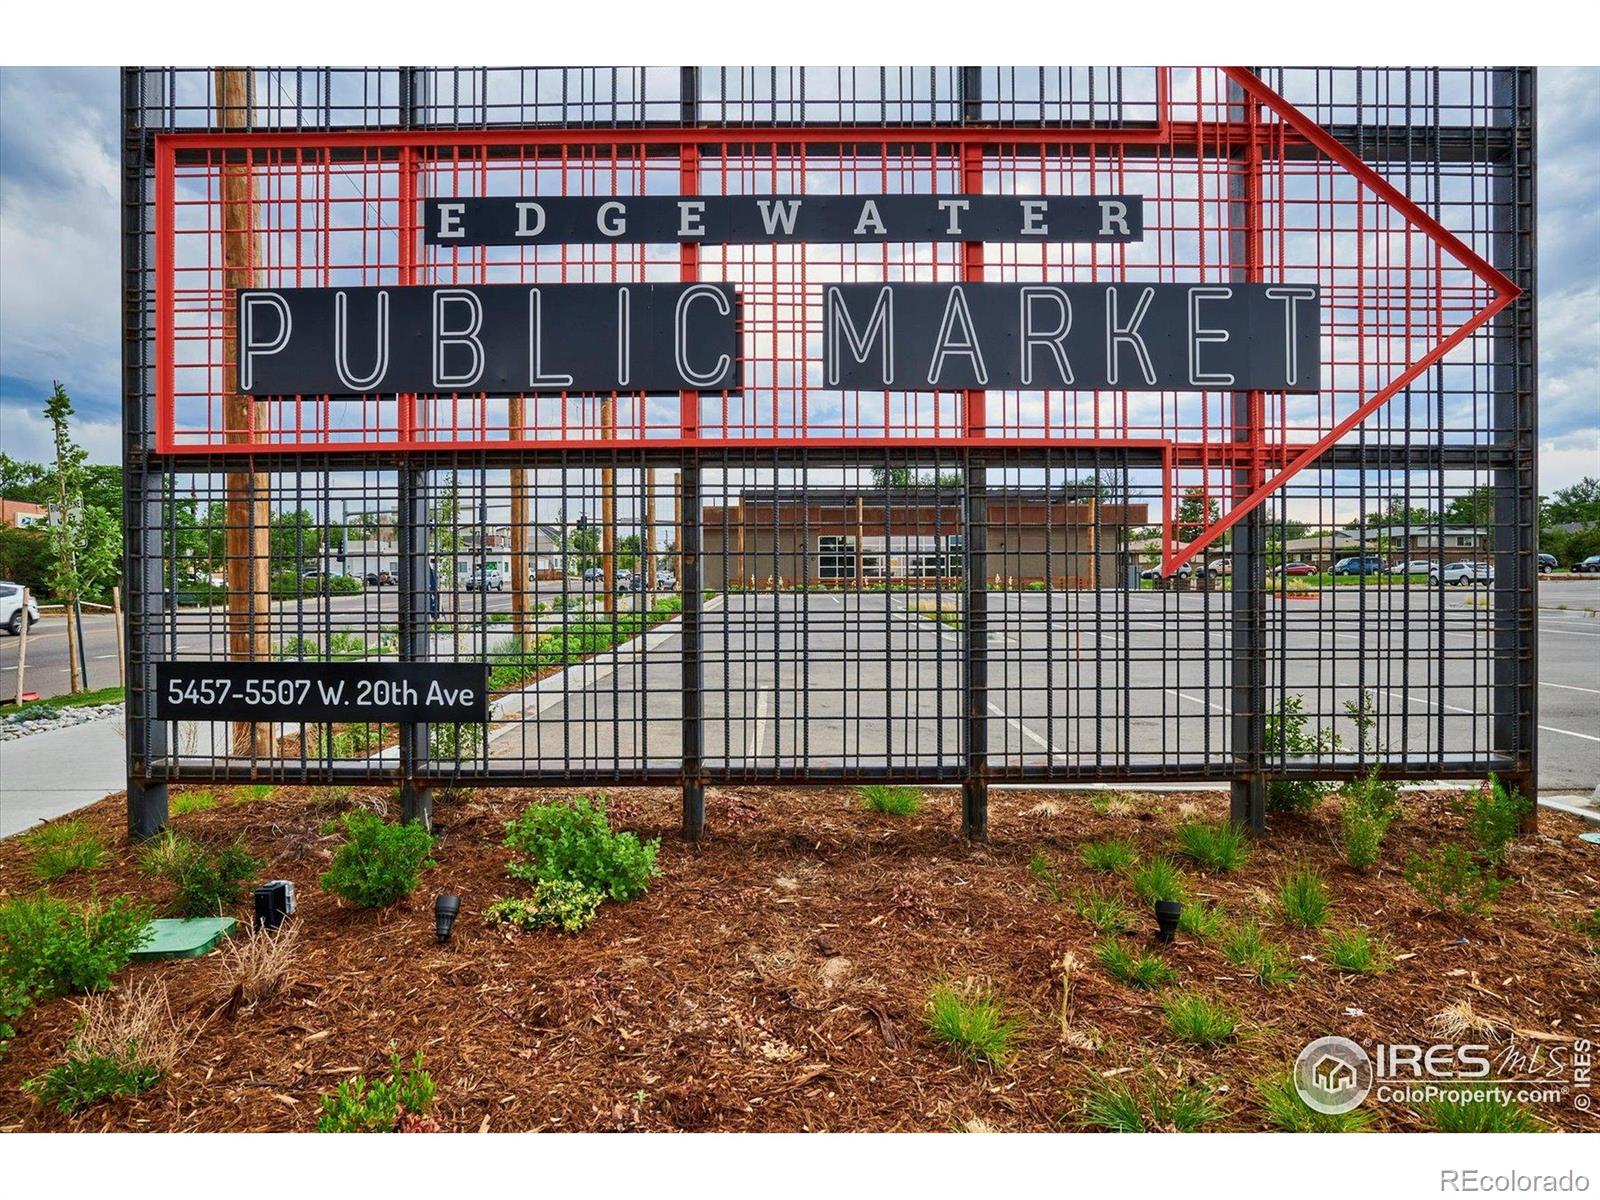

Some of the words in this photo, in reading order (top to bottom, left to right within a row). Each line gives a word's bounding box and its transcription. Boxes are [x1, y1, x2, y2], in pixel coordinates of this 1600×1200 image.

[437, 200, 1130, 238] EDGEWATER
[241, 284, 731, 390] PUBLIC
[828, 286, 1316, 386] MARKET
[168, 679, 311, 705] 5457-5507
[317, 680, 349, 706] W.
[356, 680, 418, 706] 20th
[425, 680, 474, 706] Ave
